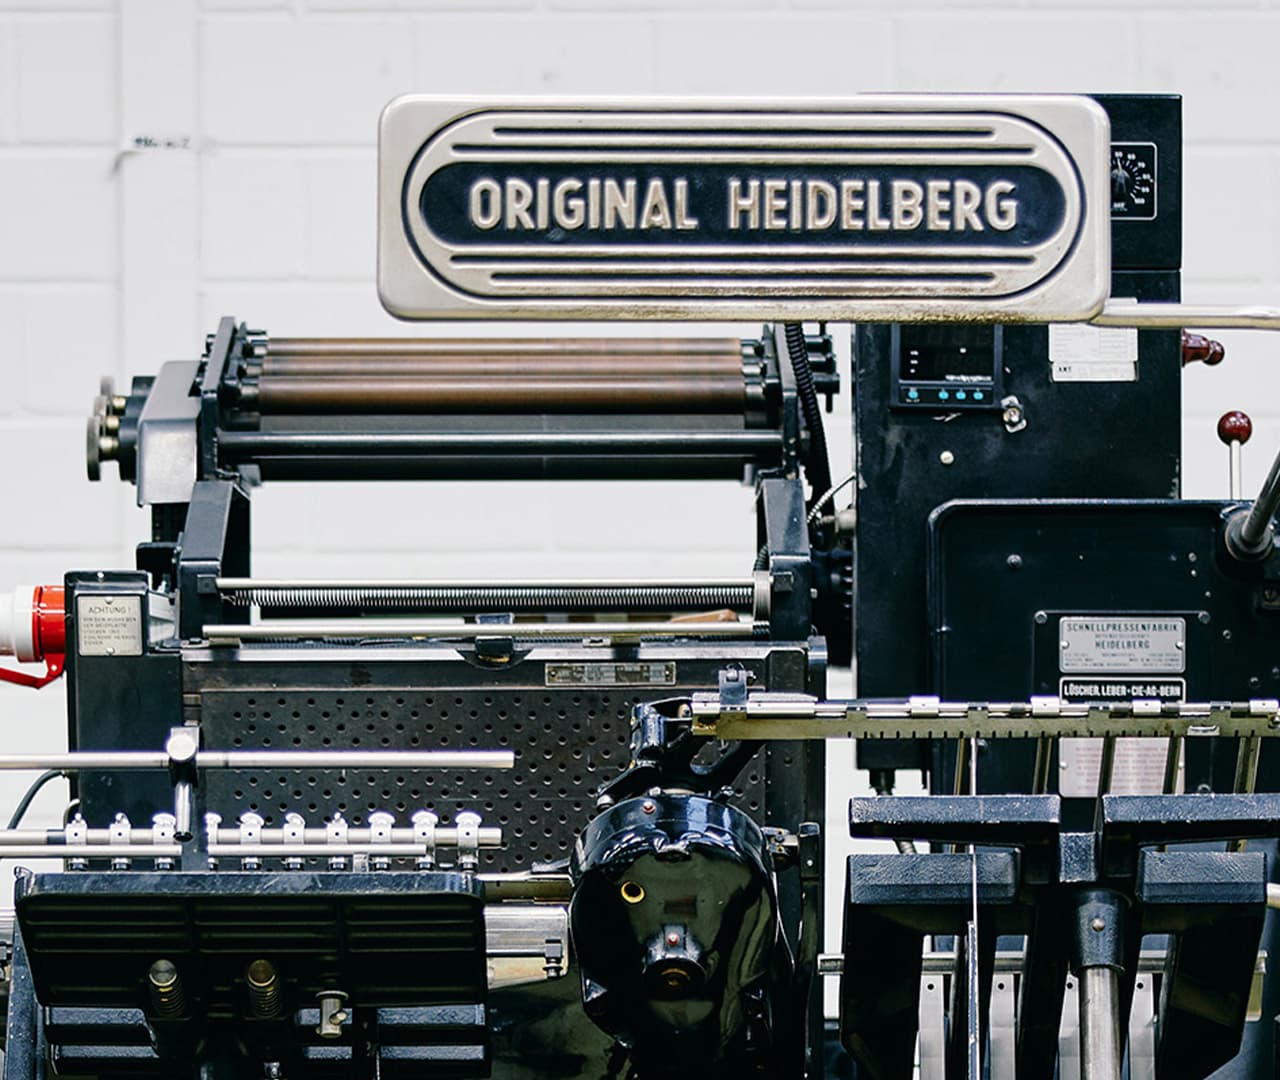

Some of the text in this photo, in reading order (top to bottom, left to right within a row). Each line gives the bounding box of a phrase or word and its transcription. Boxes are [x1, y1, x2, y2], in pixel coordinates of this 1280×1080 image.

[469, 177, 1018, 230] ORIGINAL HEIDELBERG
[1066, 623, 1178, 632] SCHNELLPRESSENFABRIK
[1095, 640, 1150, 649] HEIDELBERG
